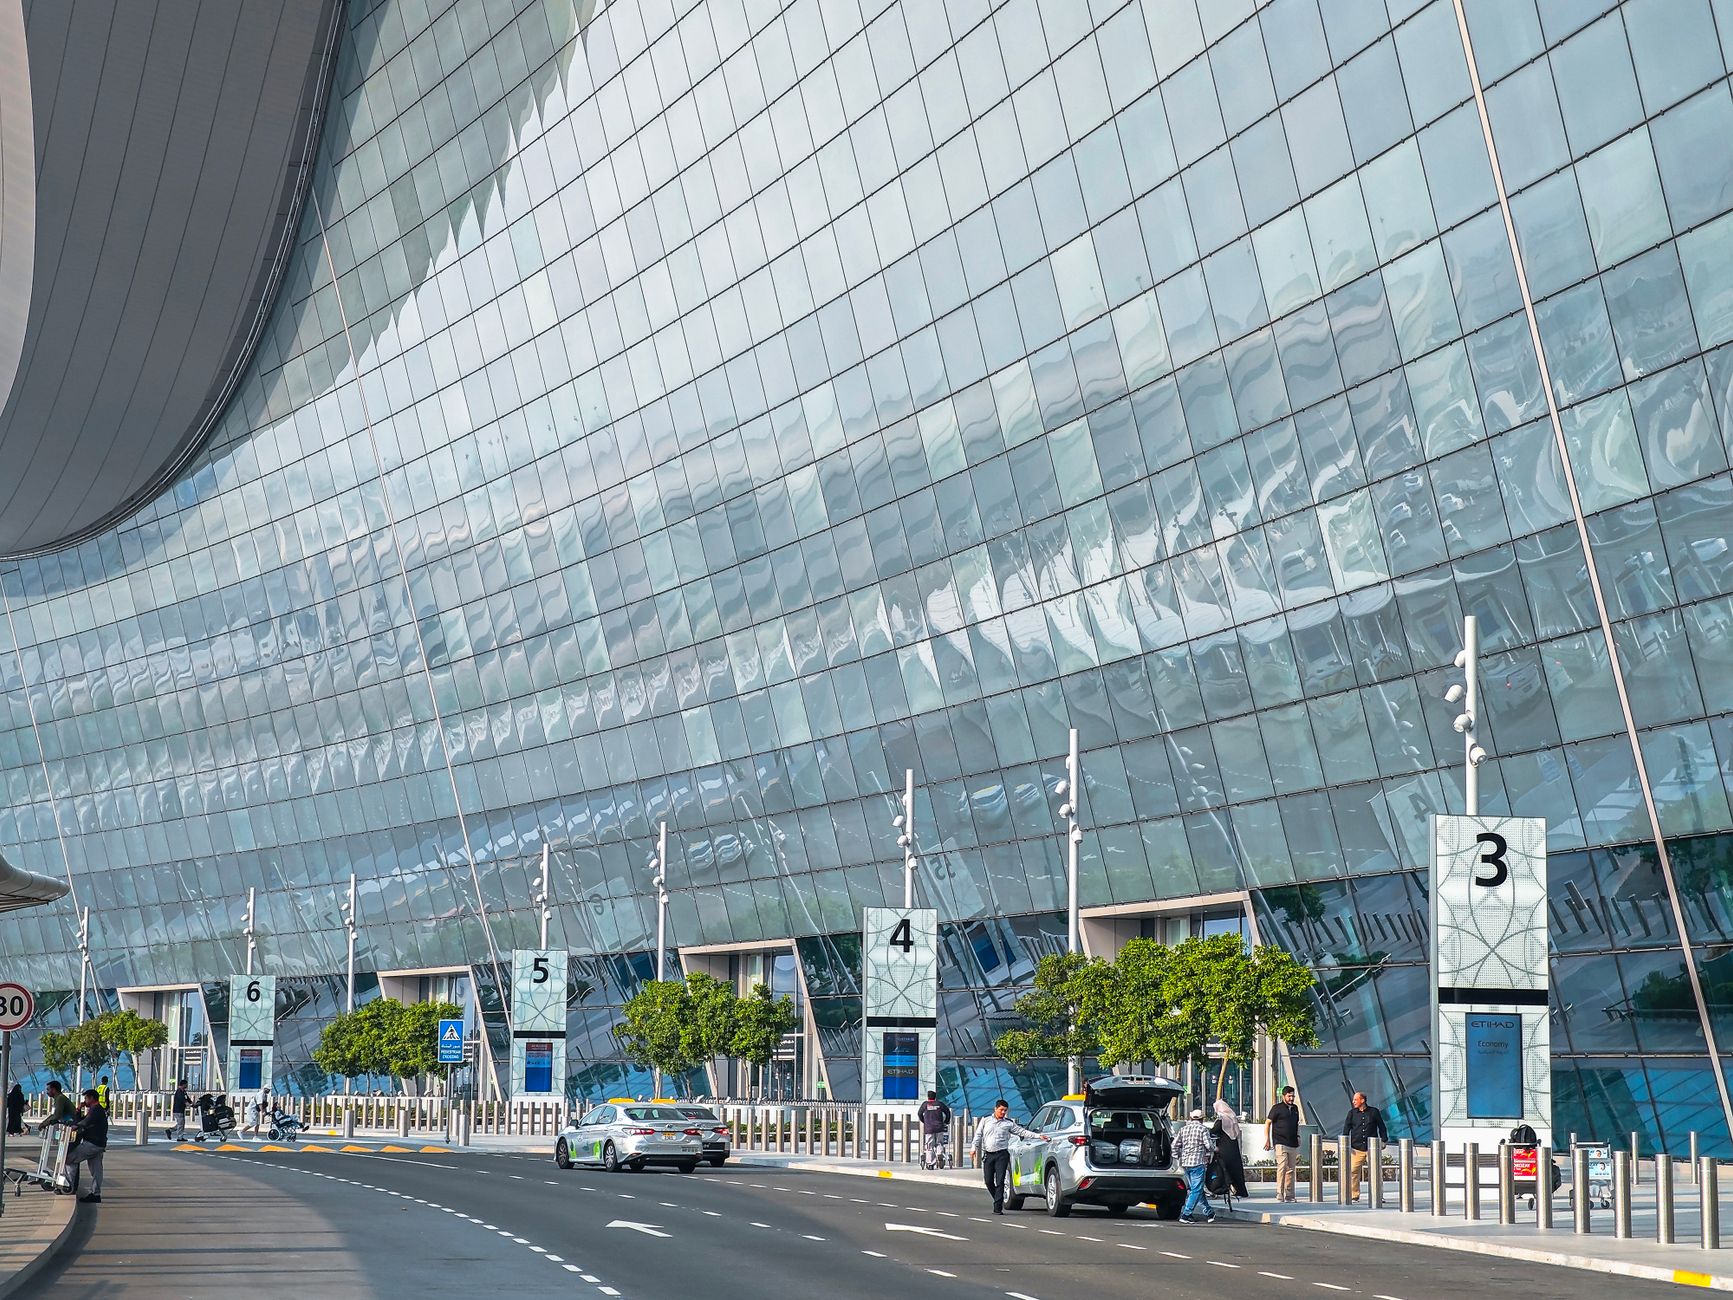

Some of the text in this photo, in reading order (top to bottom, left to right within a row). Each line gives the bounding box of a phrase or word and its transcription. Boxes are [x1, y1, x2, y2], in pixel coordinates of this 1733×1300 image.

[1476, 833, 1507, 887] 3
[890, 918, 914, 953] 4
[533, 957, 549, 984] 5
[247, 980, 260, 1002] 6
[1471, 1020, 1515, 1028] ETIHAD
[1477, 1040, 1509, 1049] Economy
